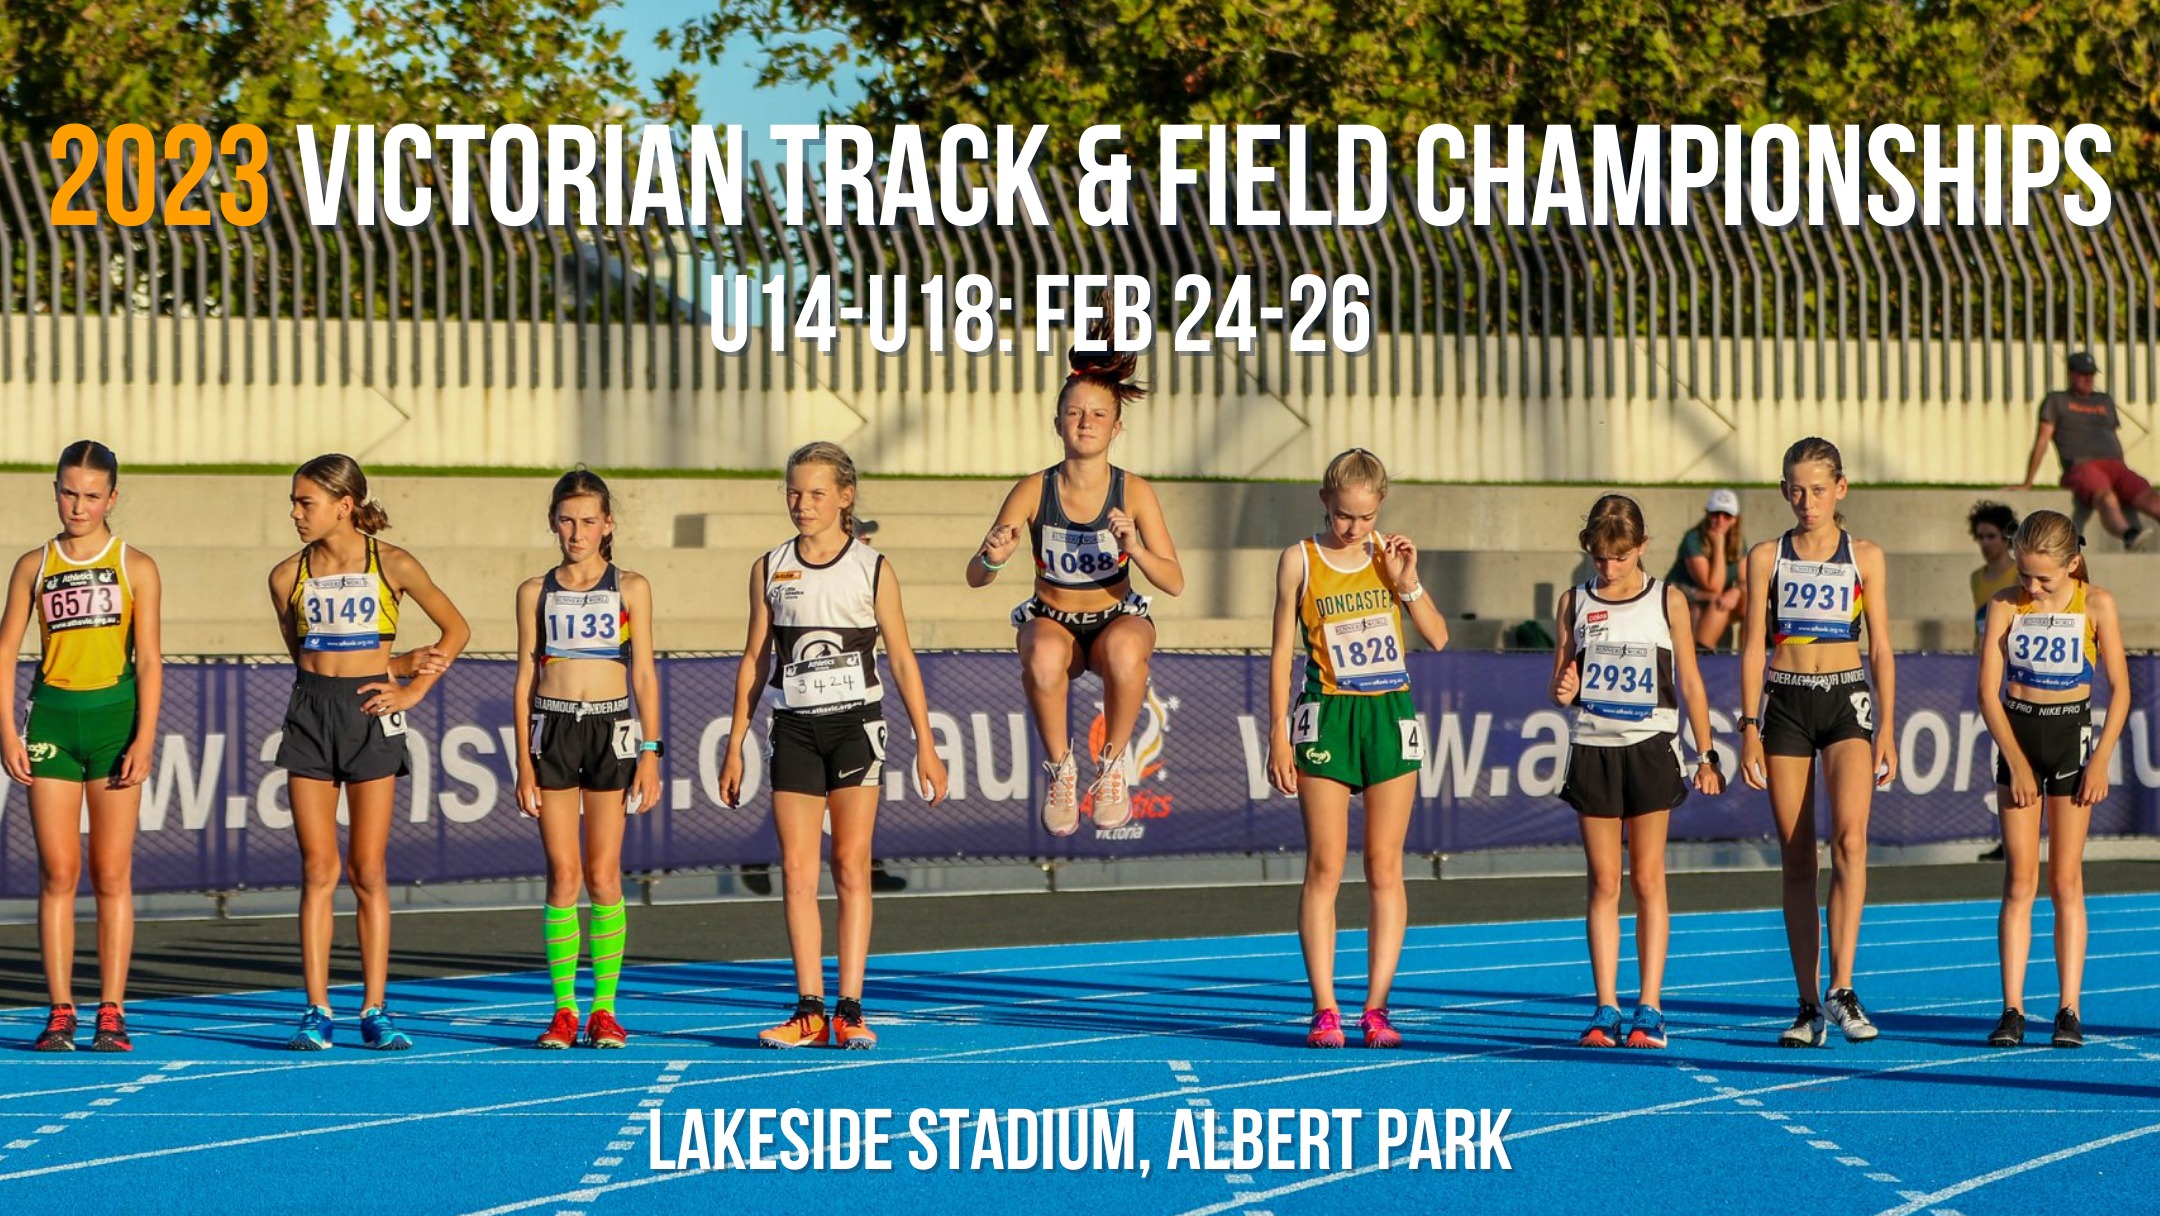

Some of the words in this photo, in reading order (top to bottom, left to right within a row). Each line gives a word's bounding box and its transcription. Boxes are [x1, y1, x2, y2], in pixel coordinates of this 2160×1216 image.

[1046, 548, 1114, 574] 1088
[62, 570, 94, 582] Athletics
[51, 588, 113, 619] 6573
[307, 596, 375, 624] 3149
[1783, 581, 1850, 612] 2931
[549, 613, 615, 641] 1133
[1332, 635, 1398, 668] 1828
[2014, 634, 2079, 663] 3281
[807, 658, 835, 668] Athletics
[1585, 662, 1654, 694] 2934
[1297, 708, 1311, 736] 4
[2038, 706, 2061, 716] NIKE
[2062, 705, 2081, 715] PRO
[620, 725, 631, 753] 7
[1408, 725, 1419, 754] 4
